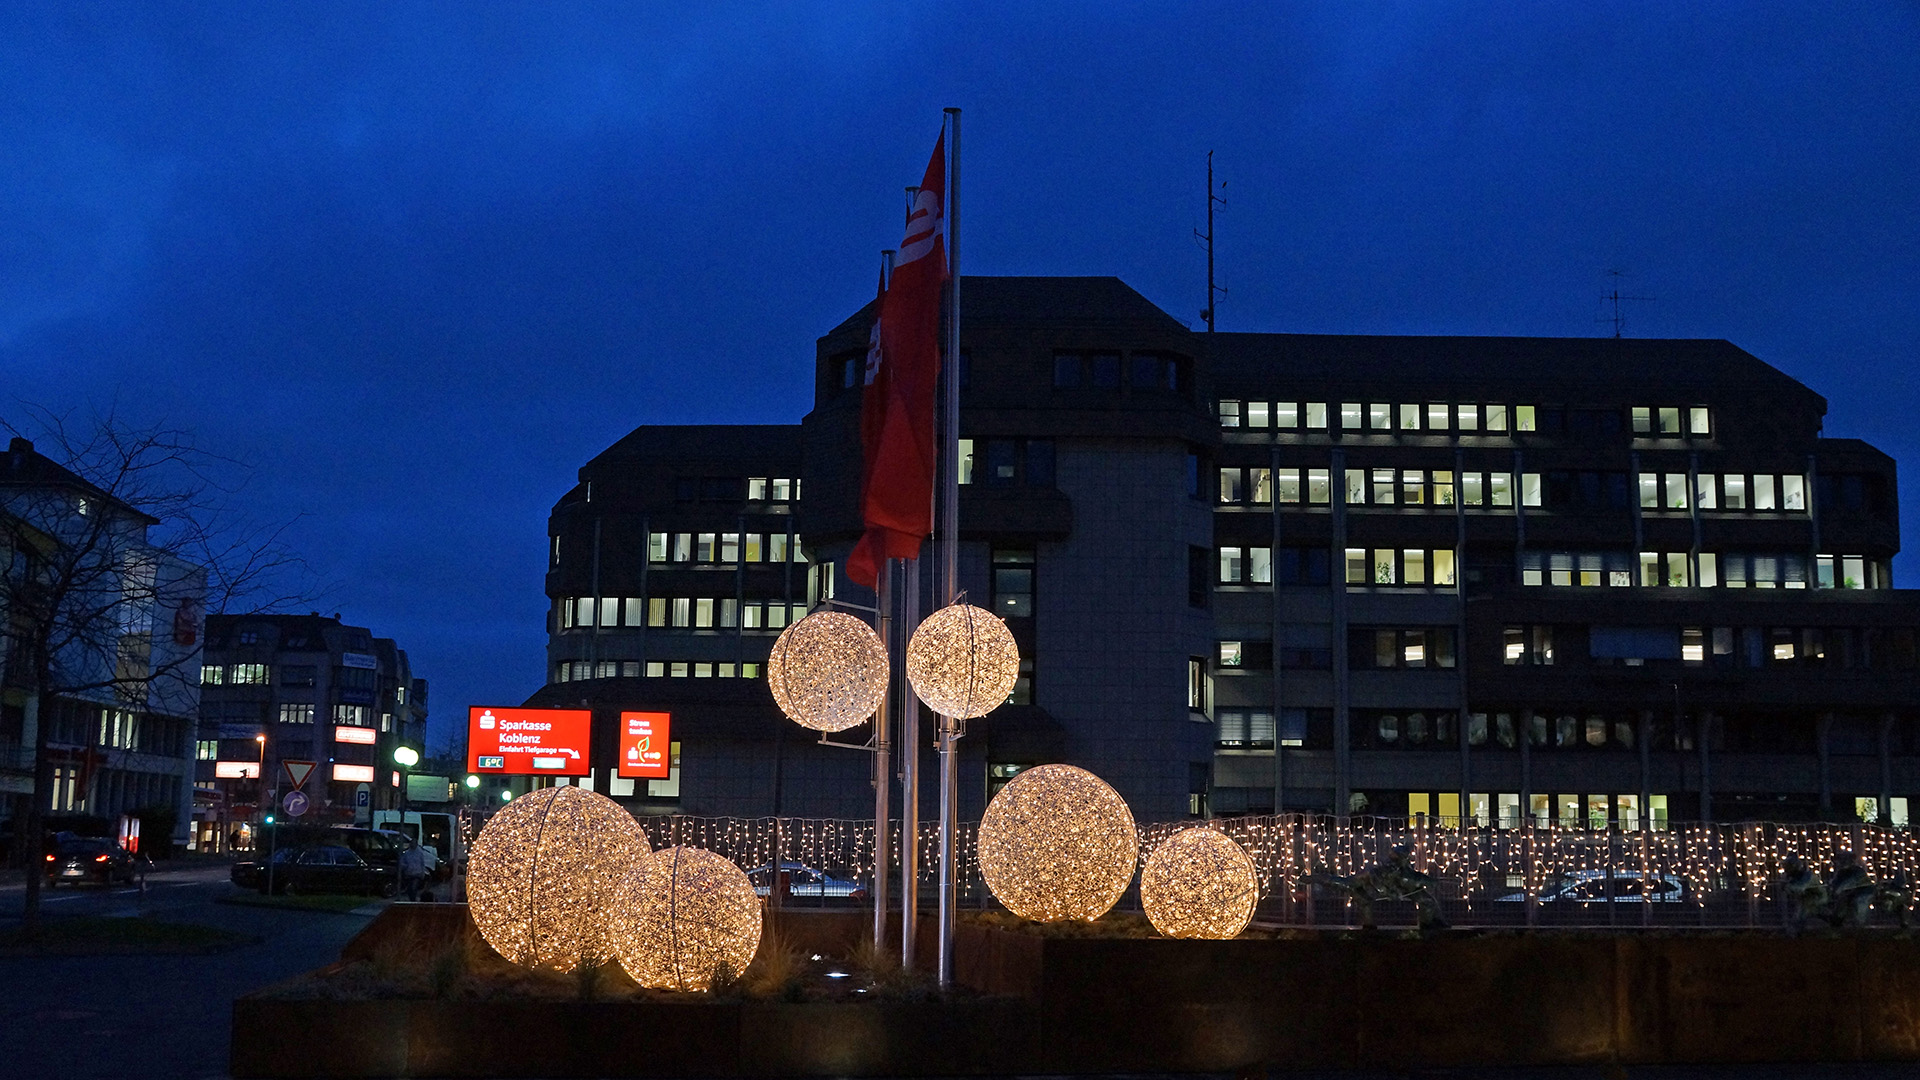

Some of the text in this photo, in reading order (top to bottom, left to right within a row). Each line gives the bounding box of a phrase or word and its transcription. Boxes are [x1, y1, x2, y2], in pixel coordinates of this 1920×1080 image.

[499, 719, 552, 732] Sparkasse
[499, 733, 541, 744] Koblenz
[499, 745, 558, 755] Einfahrt Tiefgarage
